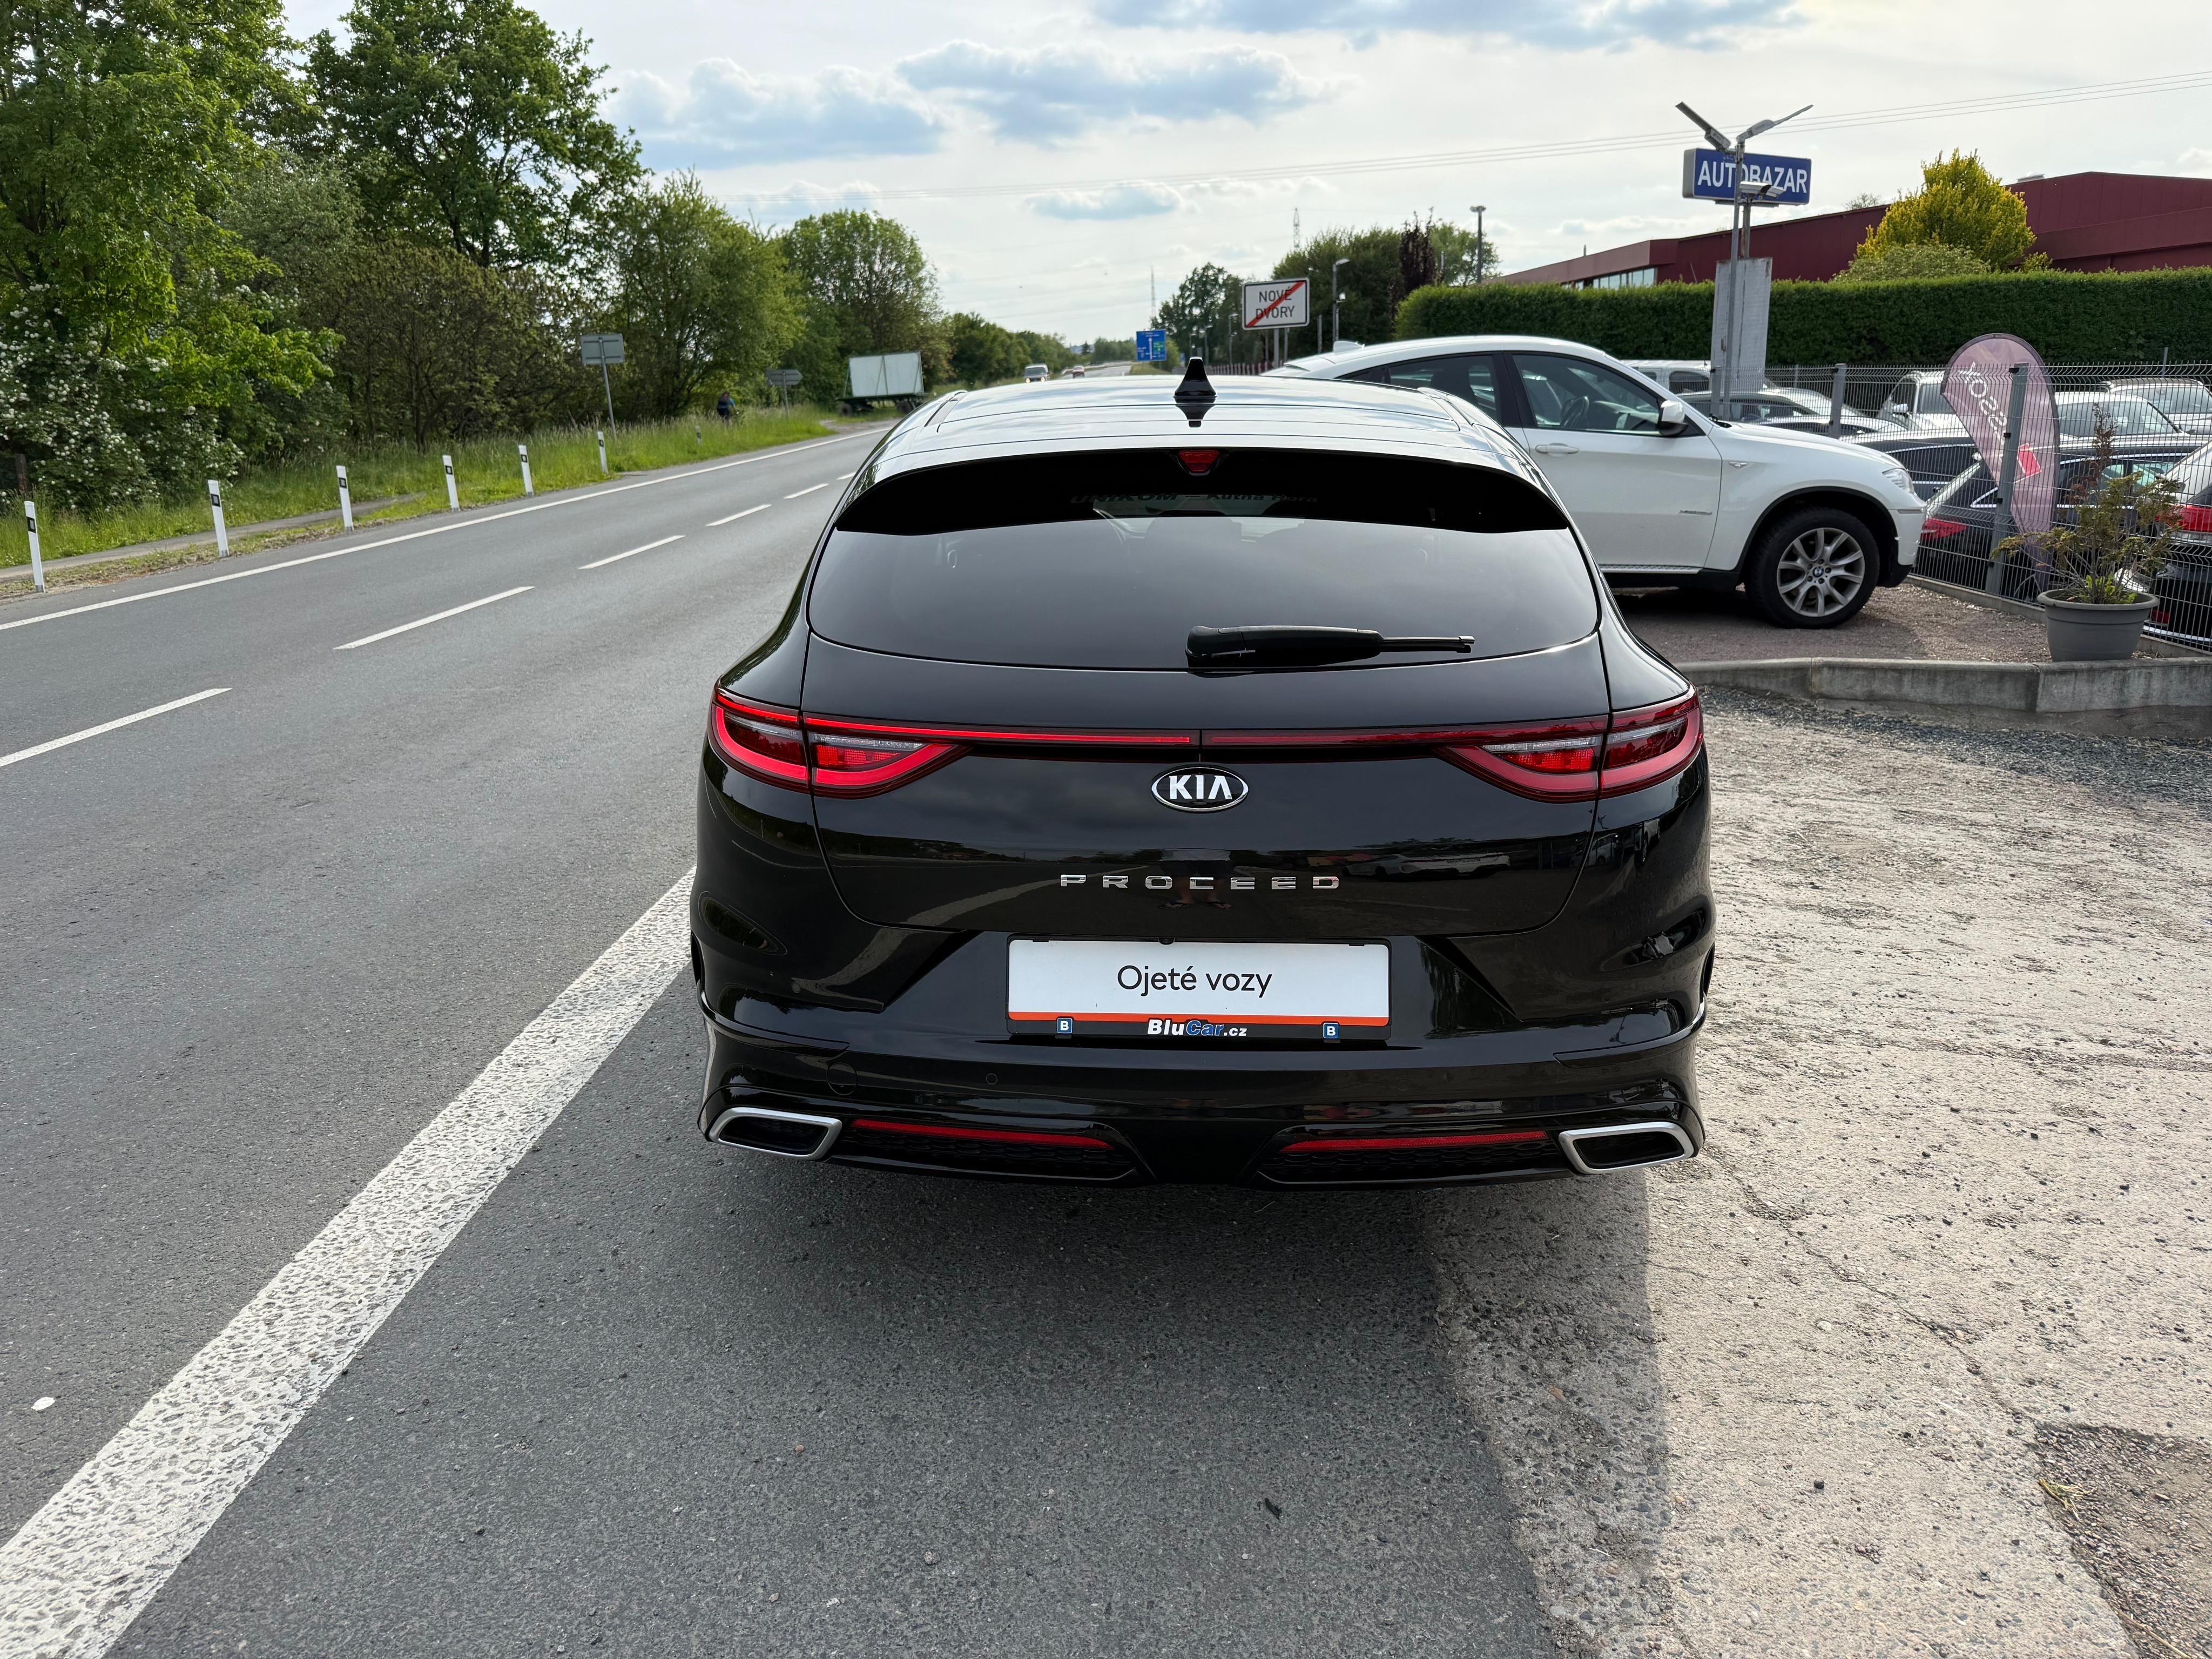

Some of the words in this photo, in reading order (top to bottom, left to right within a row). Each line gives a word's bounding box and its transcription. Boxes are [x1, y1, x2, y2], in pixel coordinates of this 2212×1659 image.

[1259, 286, 1292, 302] NOVÉ
[1256, 306, 1295, 319] DVORY
[1169, 775, 1232, 800] KIA
[1060, 874, 1339, 889] PROCEED
[1117, 965, 1197, 996] Ojeté
[1205, 973, 1272, 998] vozy
[1060, 1021, 1069, 1031] B
[1148, 1019, 1247, 1036] BluCar.cz
[1327, 1026, 1336, 1036] B
